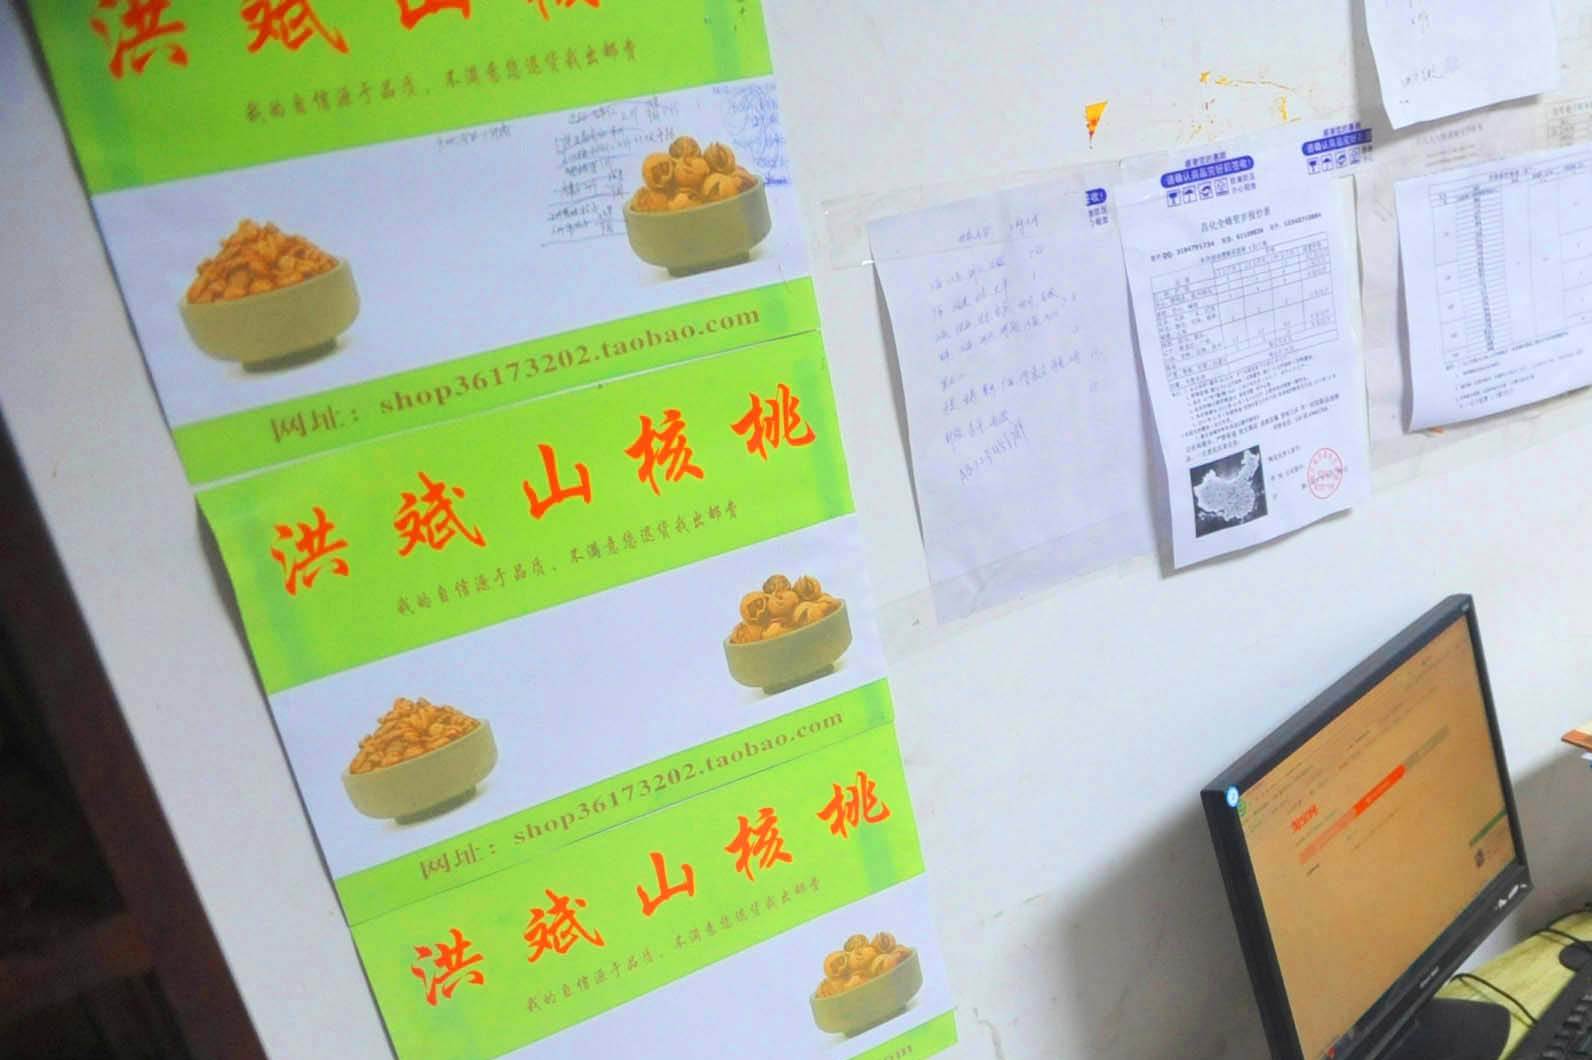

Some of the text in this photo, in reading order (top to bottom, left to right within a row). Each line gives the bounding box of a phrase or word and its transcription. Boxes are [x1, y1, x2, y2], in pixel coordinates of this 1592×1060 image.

[380, 307, 762, 415] shop36173202.taobao.com
[270, 383, 818, 596] 洪斌山核桃
[513, 714, 844, 846] shop36173202.taobao.com
[411, 771, 892, 1007] 洪斌山核桃
